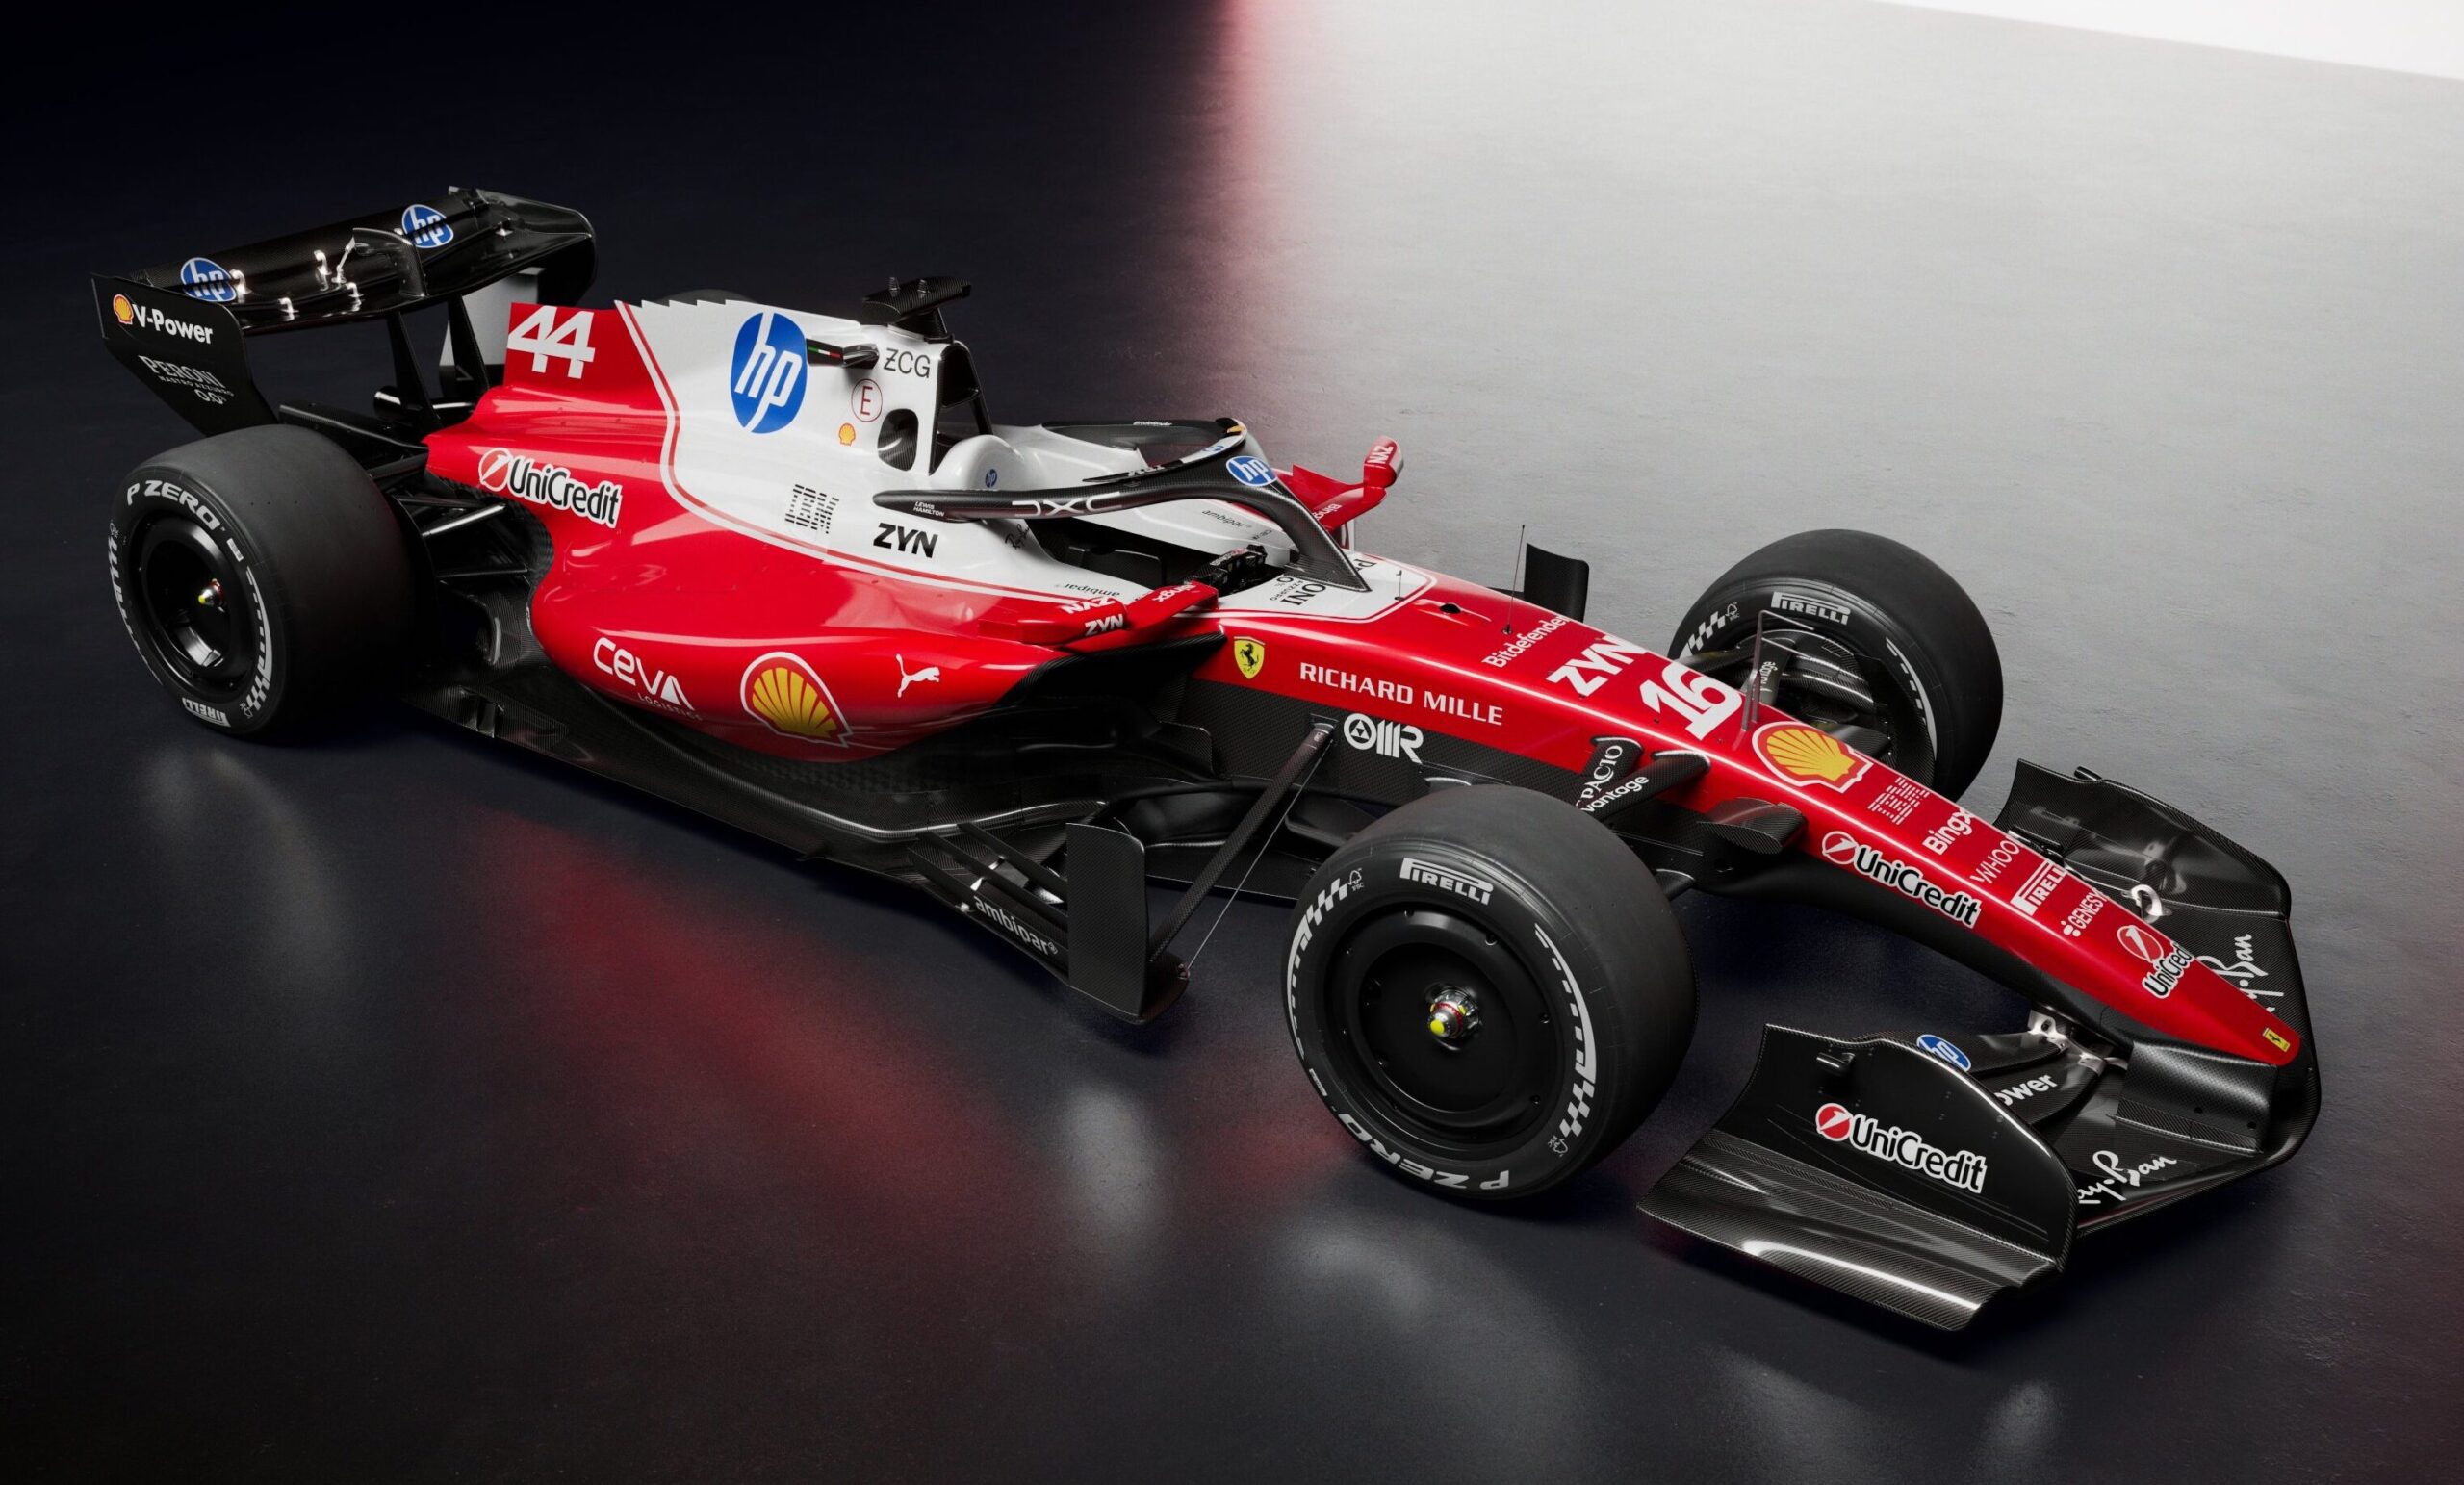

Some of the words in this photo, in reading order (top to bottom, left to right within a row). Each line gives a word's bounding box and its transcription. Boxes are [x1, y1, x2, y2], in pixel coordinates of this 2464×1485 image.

[407, 205, 447, 246] hp
[187, 259, 229, 301] hp
[133, 304, 213, 344] V-Power
[507, 305, 595, 379] 44
[138, 355, 225, 389] PERONI
[732, 311, 808, 433] hp
[1228, 458, 1273, 484] hp
[127, 483, 140, 506] P
[509, 459, 621, 526] UniCredit
[912, 506, 945, 518] HAMILTON
[914, 501, 935, 510] LEWIS
[873, 523, 938, 559] ZYN
[1085, 614, 1123, 636] ZYN
[1771, 591, 1851, 626] PIRELLI
[1481, 614, 1573, 668] Bitdefender
[1545, 634, 1650, 696] ZYN
[182, 697, 231, 728] PIRELLI
[1300, 662, 1413, 704] RICHARD
[1424, 691, 1503, 726] MILLE
[1639, 660, 1742, 740] 16
[1399, 857, 1494, 906] PIRELLI
[1969, 840, 2020, 884] WHOO
[1855, 847, 1980, 927] UniCredit
[2010, 858, 2067, 916] PIRELL
[2067, 890, 2107, 930] GENESY
[2143, 942, 2194, 997] UniCred
[1918, 1037, 1969, 1071] hp
[1338, 1114, 1469, 1189] ZERO
[1852, 1117, 1988, 1193] UniCredit
[1479, 1170, 1509, 1190] P
